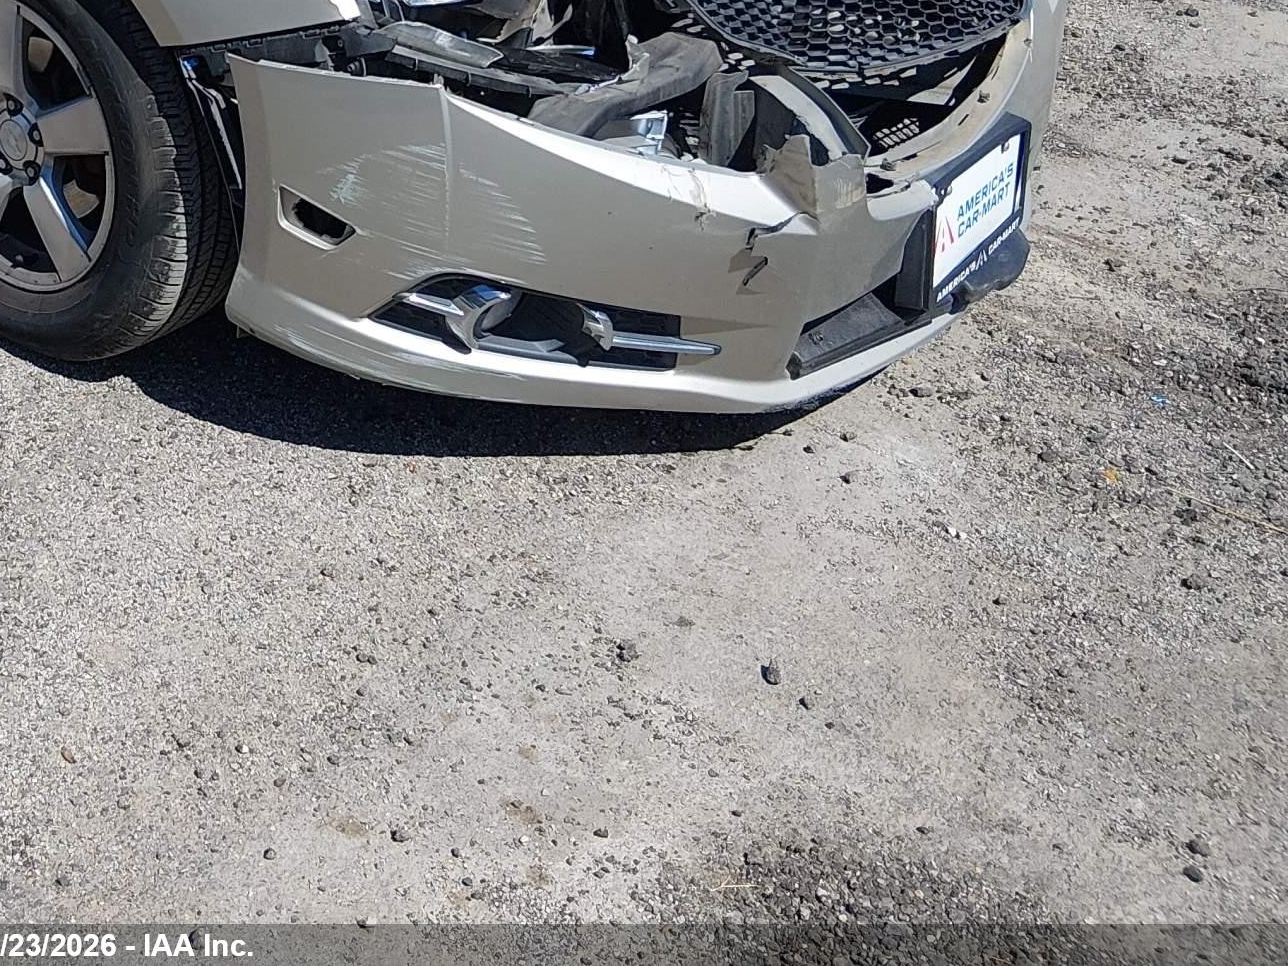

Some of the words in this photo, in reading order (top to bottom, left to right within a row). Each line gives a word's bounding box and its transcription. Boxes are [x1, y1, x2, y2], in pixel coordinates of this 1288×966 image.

[957, 162, 1014, 221] AMERICA'S
[957, 182, 1010, 238] CAR-MART
[936, 260, 976, 303] AMERICA'S
